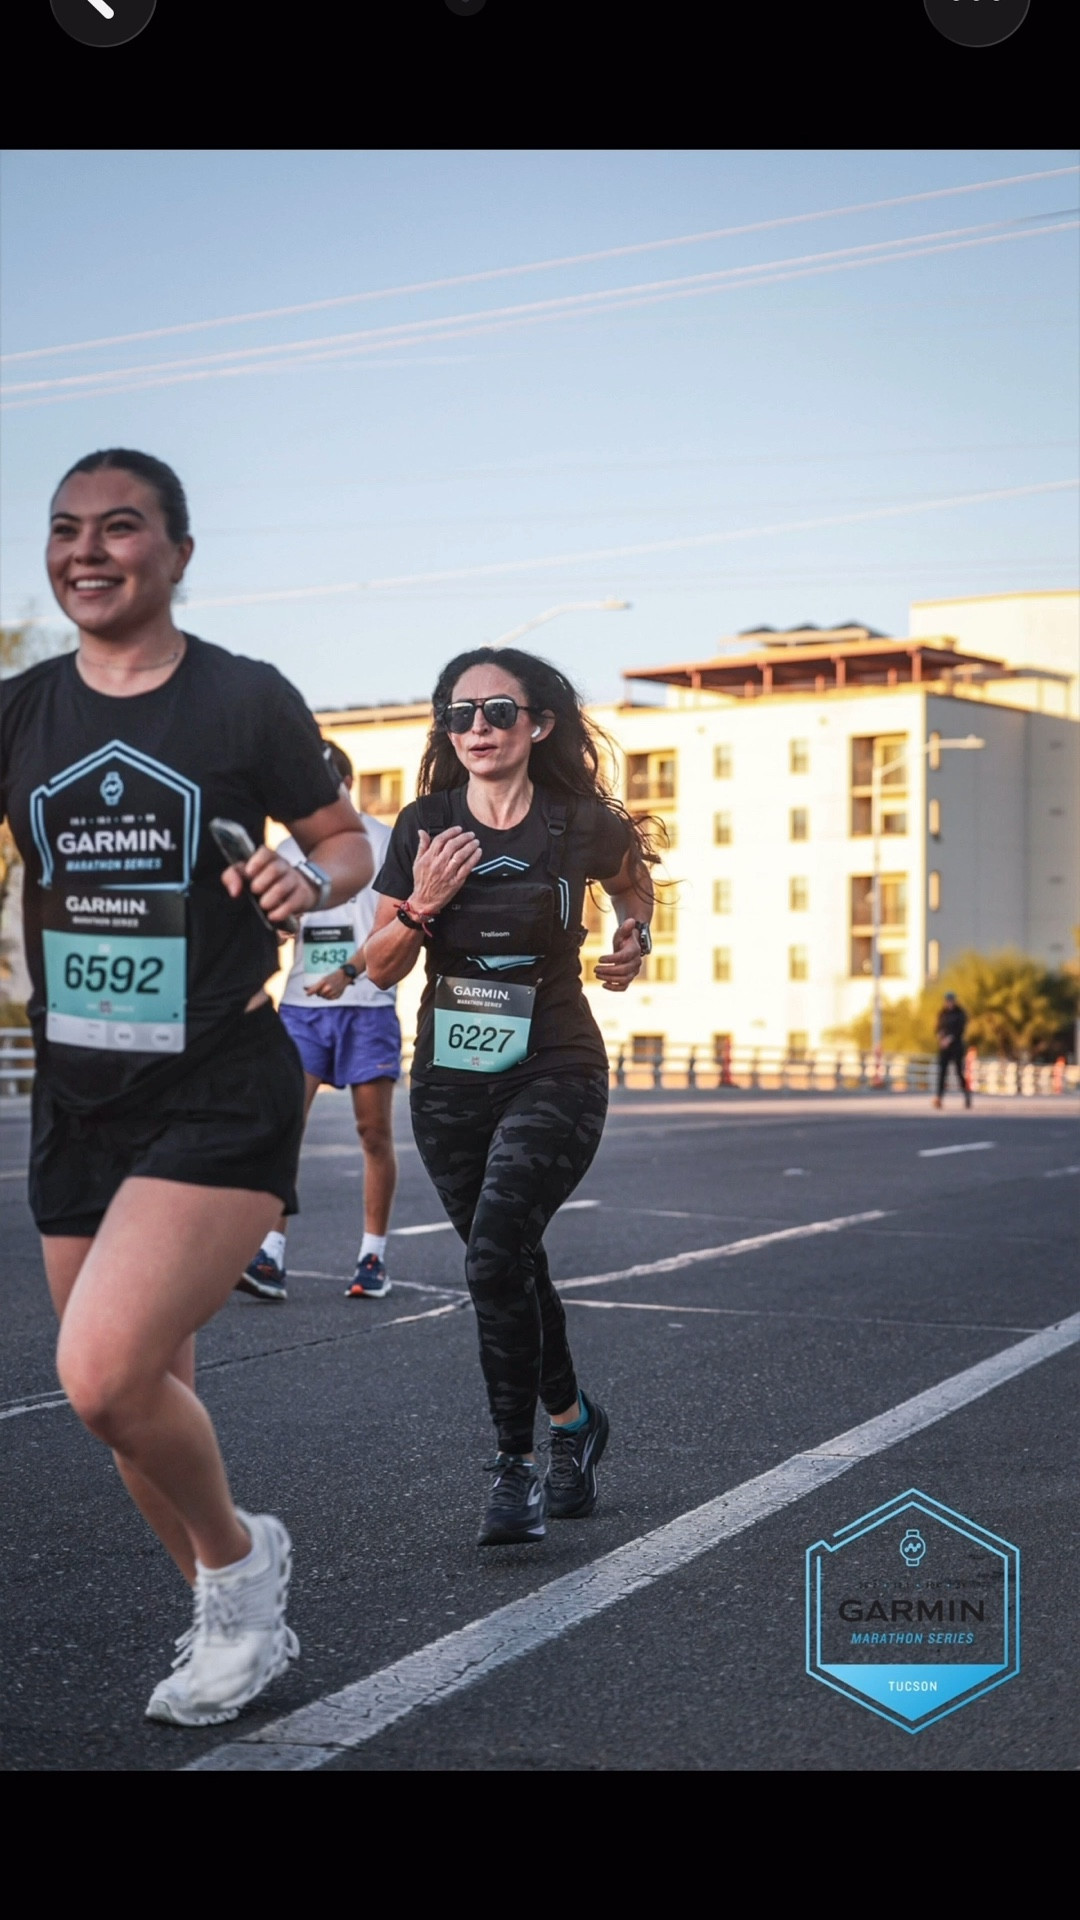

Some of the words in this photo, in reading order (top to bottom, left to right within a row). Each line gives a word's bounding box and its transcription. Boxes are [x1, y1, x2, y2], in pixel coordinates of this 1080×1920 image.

[56, 829, 172, 854] GARMIN
[65, 860, 122, 872] MARATHON
[123, 857, 163, 871] SERIES
[65, 895, 146, 915] GARMIN
[310, 949, 348, 965] 6433
[64, 953, 164, 994] 6592
[453, 985, 509, 1000] GARMIN
[448, 1023, 515, 1053] 6227
